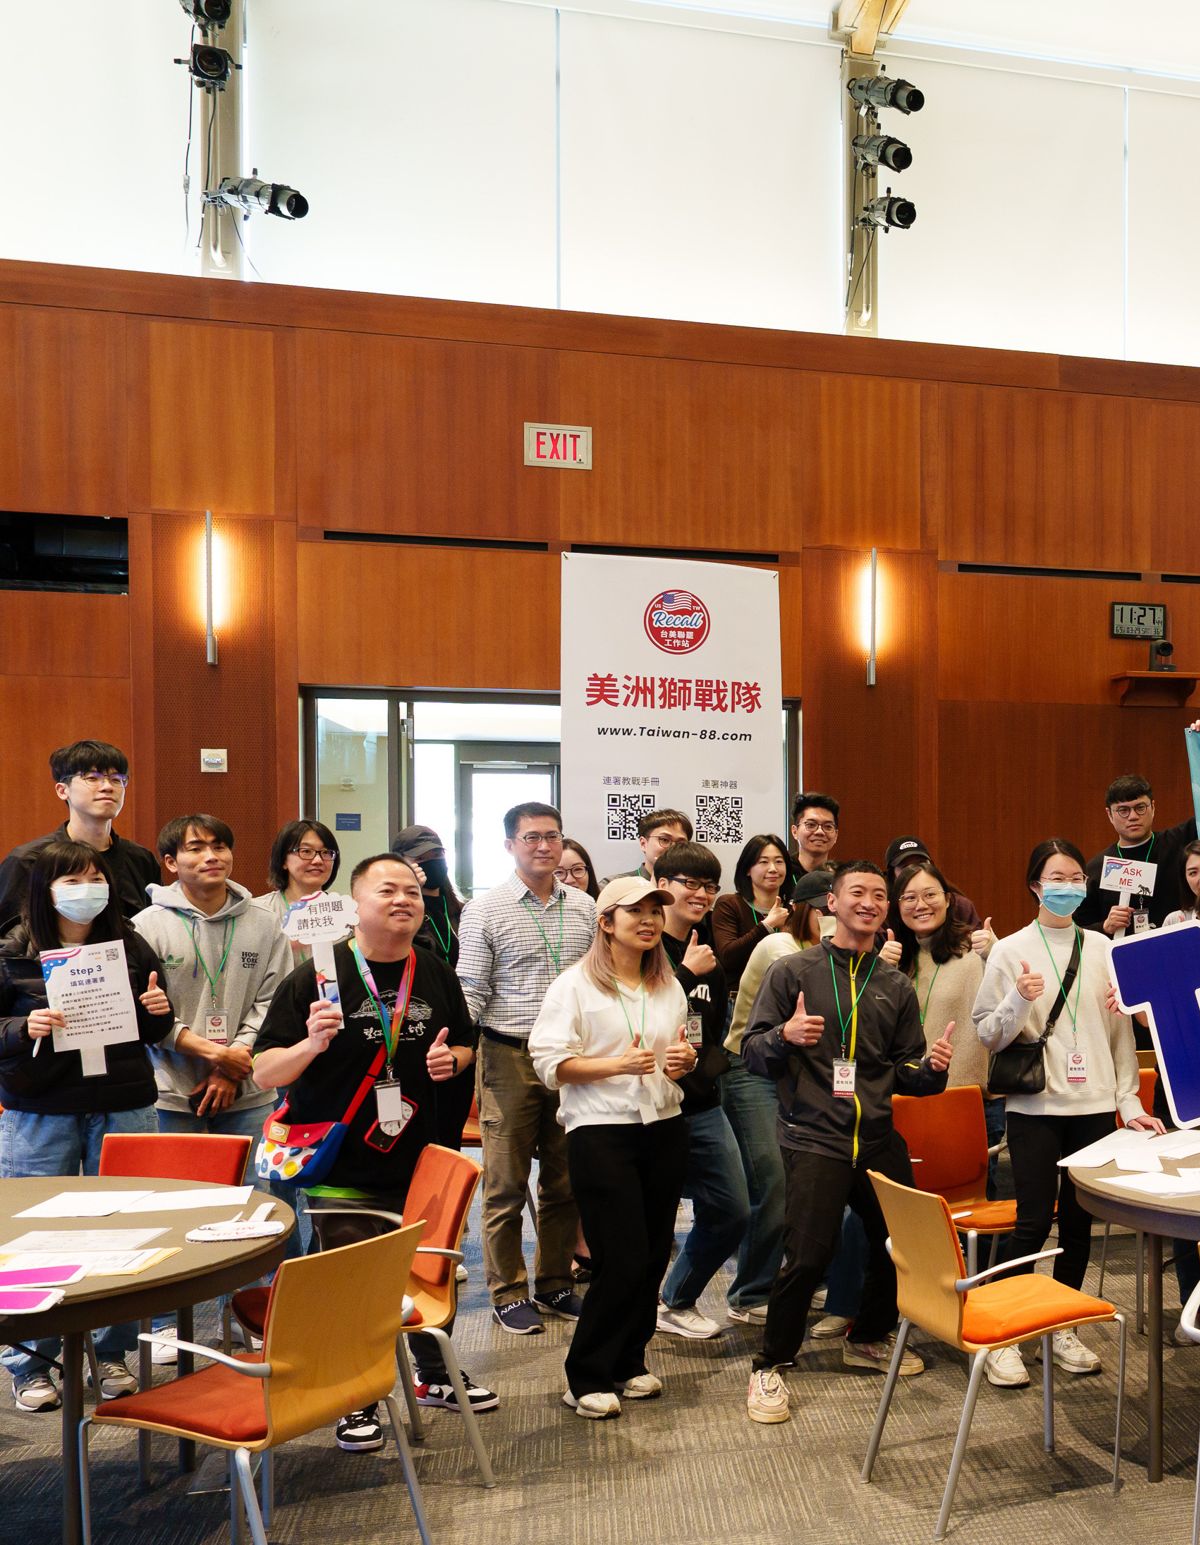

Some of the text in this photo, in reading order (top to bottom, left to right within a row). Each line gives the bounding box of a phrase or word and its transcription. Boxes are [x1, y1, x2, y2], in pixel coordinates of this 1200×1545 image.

[536, 431, 580, 461] EXIT
[653, 610, 703, 628] Recall
[1120, 606, 1156, 625] 11:27
[664, 639, 690, 648] 工作站
[585, 672, 762, 714] 美洲獅戰隊
[597, 726, 752, 742] www.Taiwan-88.com
[602, 775, 660, 787] 連署教戰手冊
[701, 779, 738, 790] 連署神器
[1122, 867, 1142, 877] ASK
[1119, 877, 1133, 887] ME
[307, 900, 344, 915] 有問題
[297, 917, 335, 931] 請找我
[70, 964, 102, 976] Step 3
